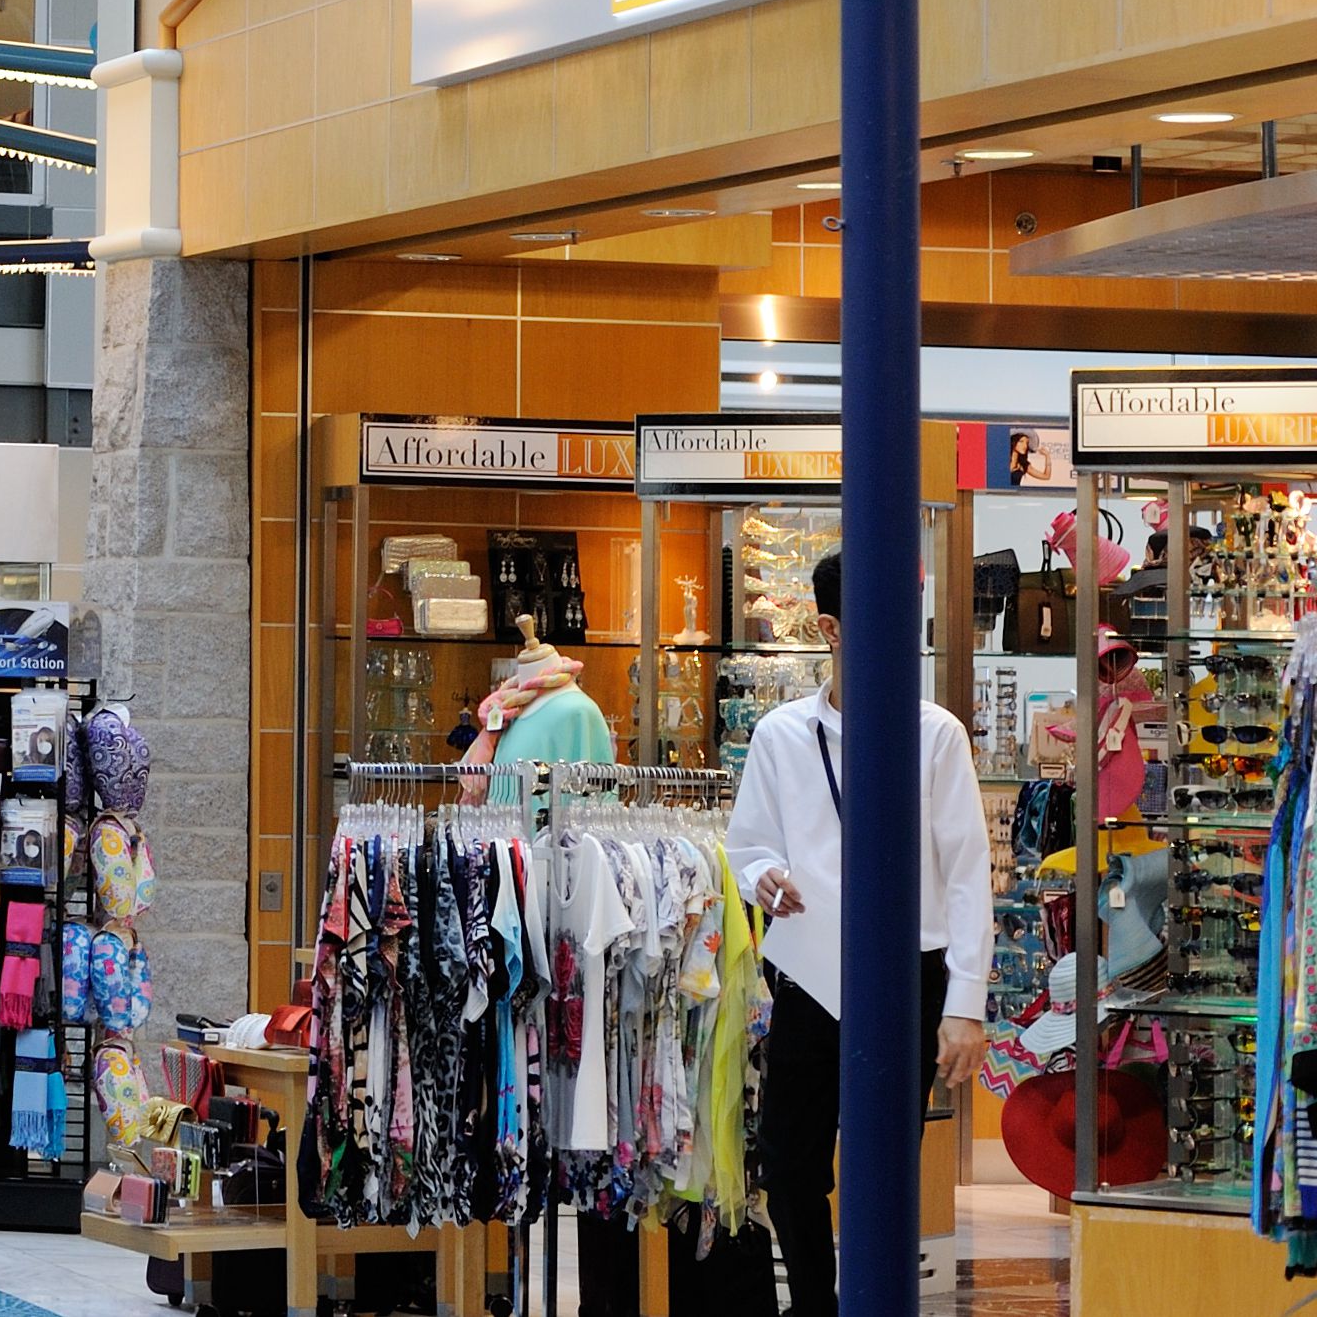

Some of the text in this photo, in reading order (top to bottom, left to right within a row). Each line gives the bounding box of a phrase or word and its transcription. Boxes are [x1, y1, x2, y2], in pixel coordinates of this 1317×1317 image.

[1083, 387, 1235, 414] Affordable
[646, 429, 767, 451] Affordable
[375, 435, 547, 470] Affordable
[20, 656, 65, 670] Station
